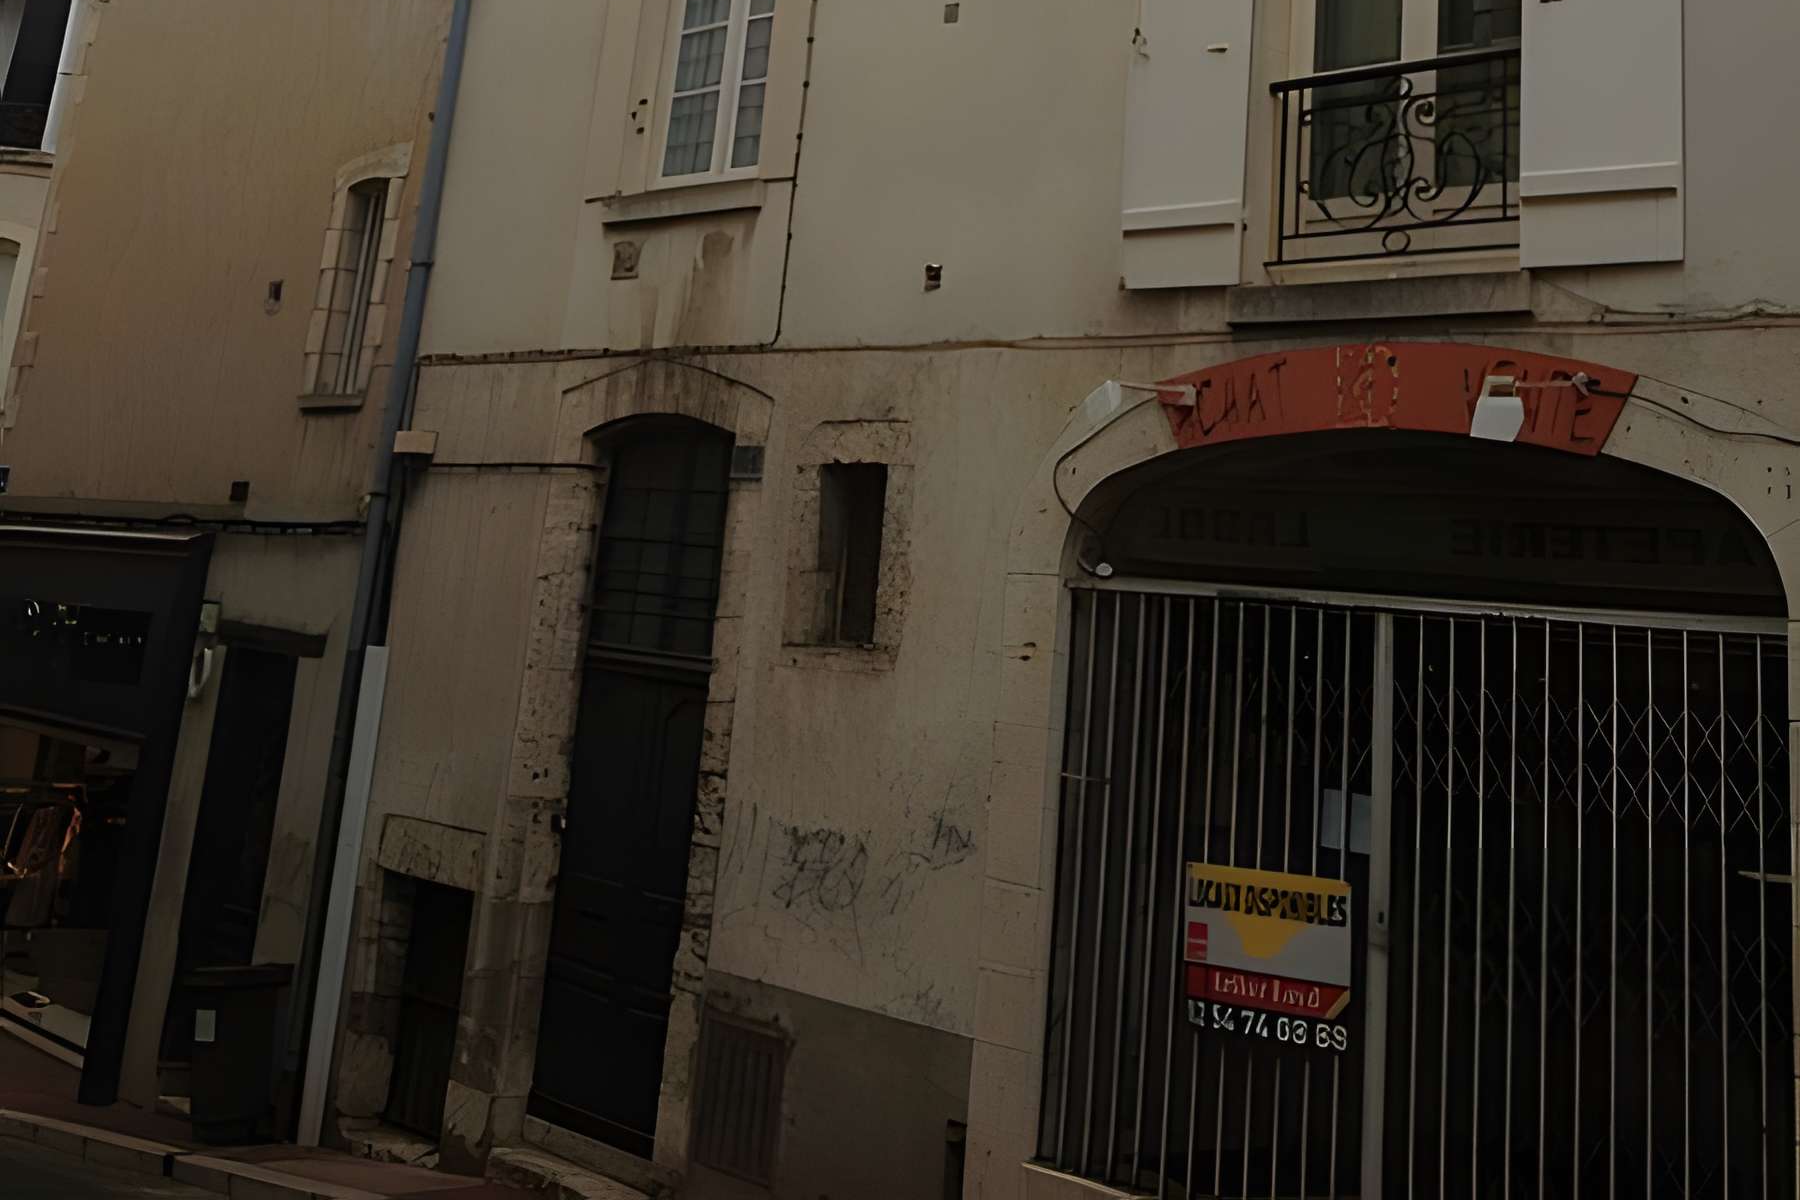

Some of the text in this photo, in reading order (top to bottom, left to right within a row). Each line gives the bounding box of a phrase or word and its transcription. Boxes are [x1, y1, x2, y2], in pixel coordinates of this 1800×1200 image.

[1172, 358, 1597, 440] CHAT VNTE
[1241, 1010, 1269, 1038] 74
